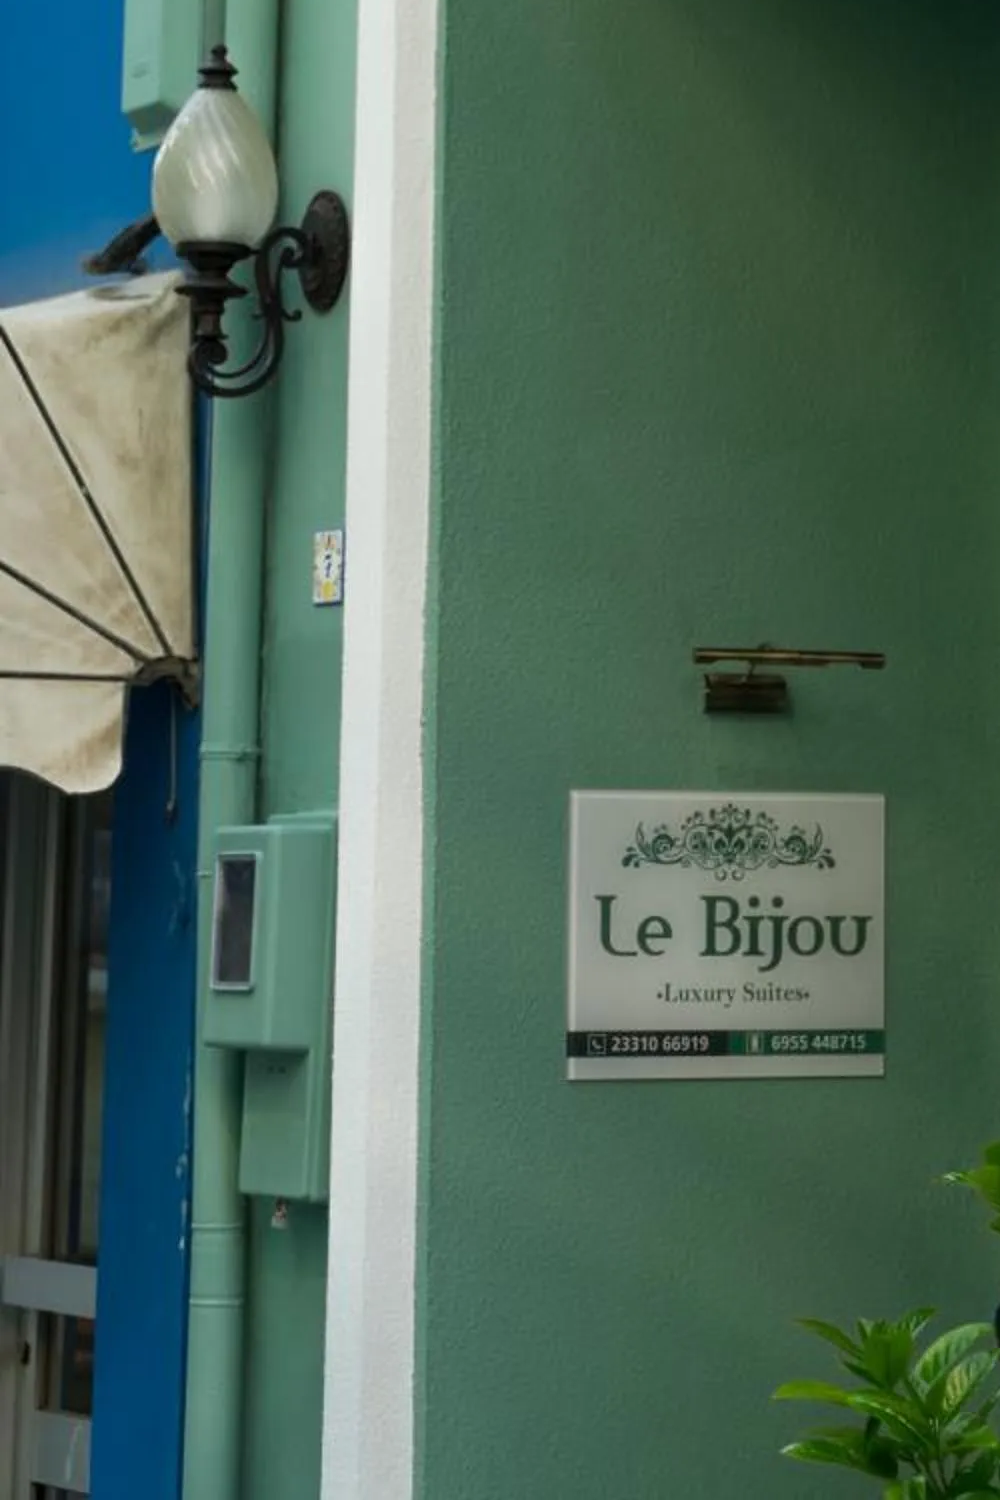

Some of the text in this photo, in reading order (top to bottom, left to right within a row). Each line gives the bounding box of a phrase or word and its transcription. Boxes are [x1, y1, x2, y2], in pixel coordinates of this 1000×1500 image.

[594, 894, 873, 973] Le Bijou
[611, 1034, 710, 1052] 23310 66919
[771, 1033, 867, 1051] 6955 448715
